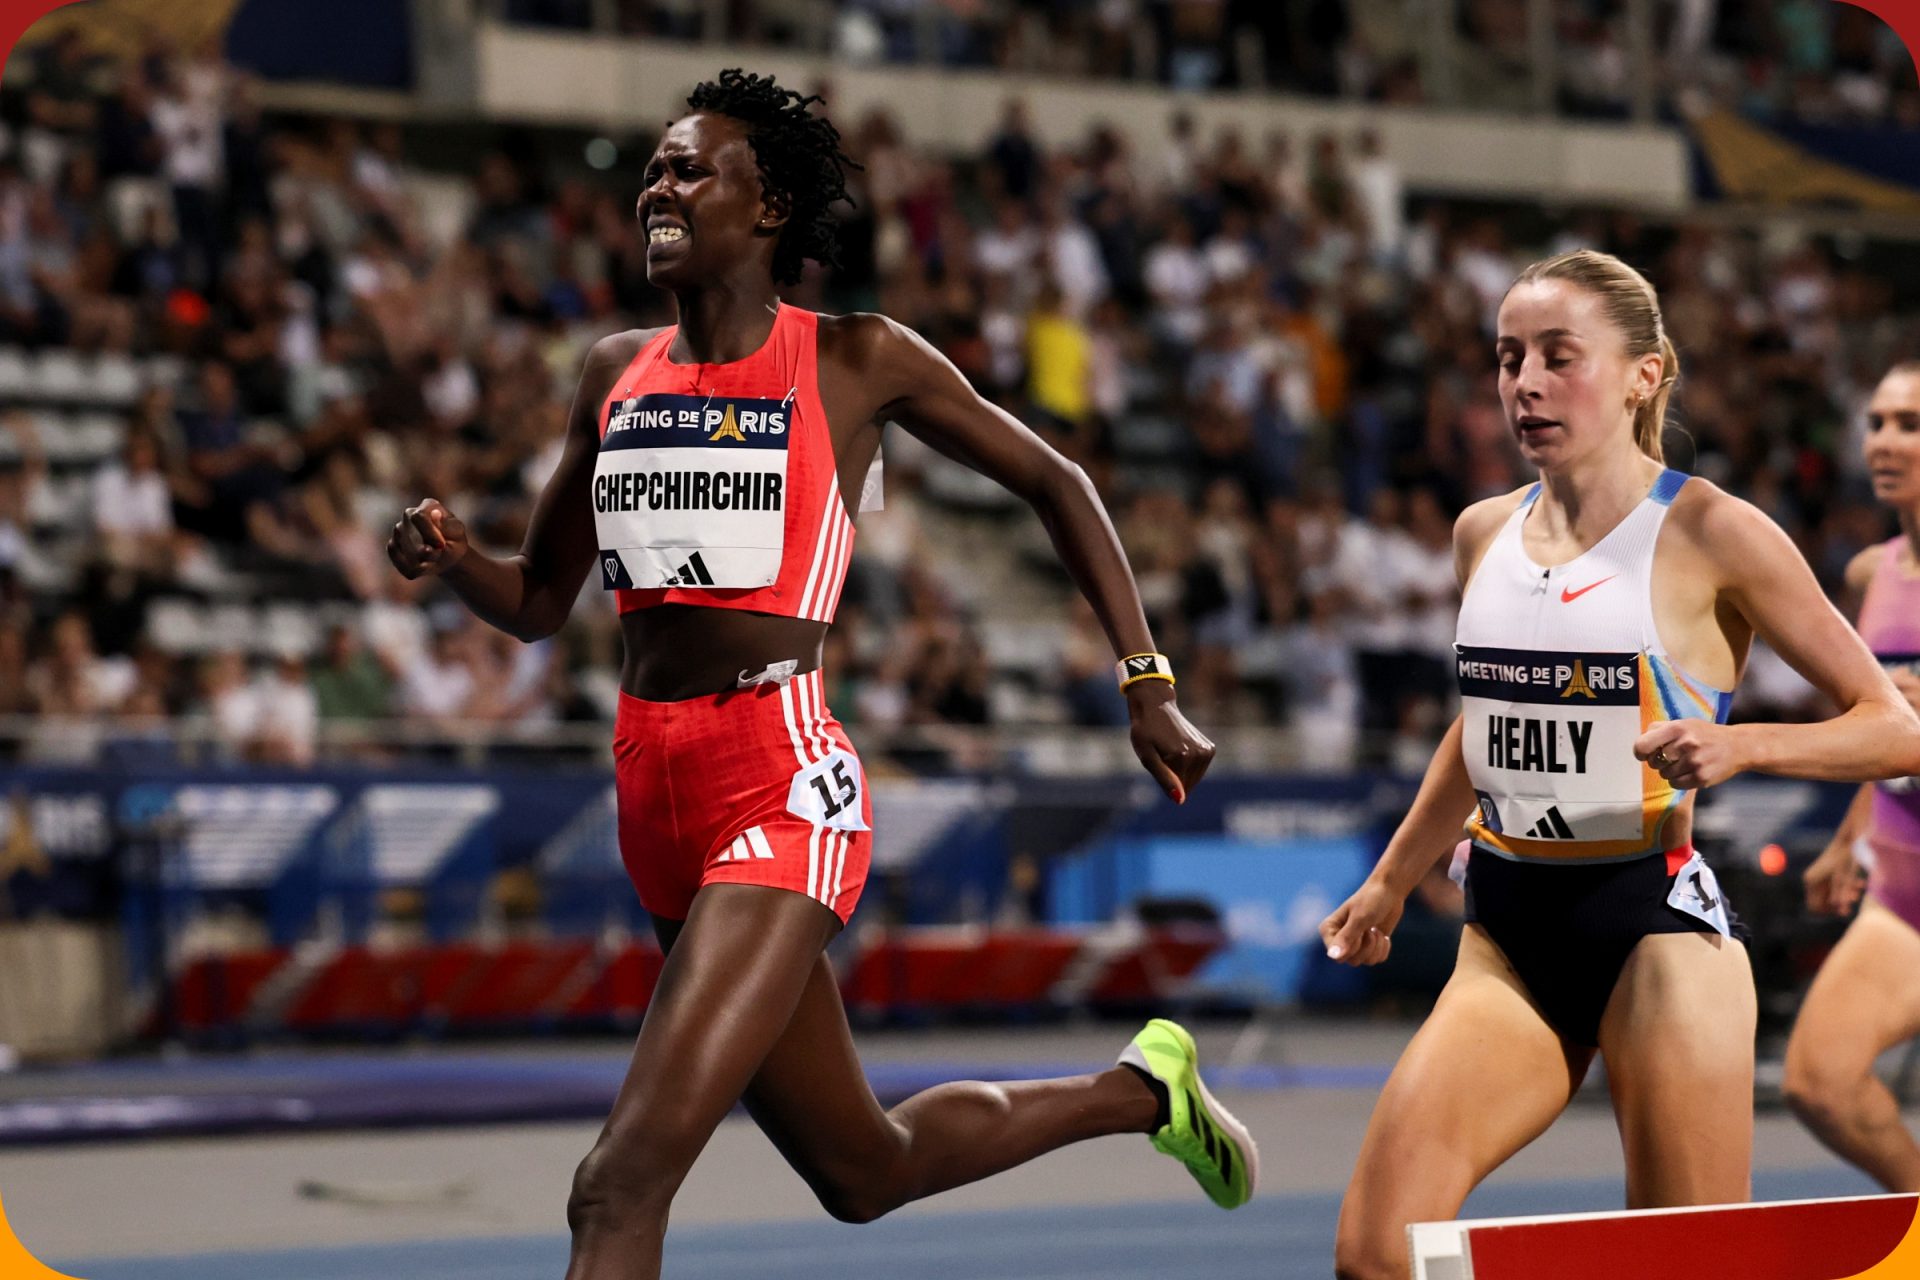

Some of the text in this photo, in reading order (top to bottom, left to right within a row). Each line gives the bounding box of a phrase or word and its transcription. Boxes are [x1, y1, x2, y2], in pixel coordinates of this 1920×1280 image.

[607, 403, 786, 442] MEETING DE PARIS
[595, 471, 783, 513] CHEPCHIRCHIR
[1459, 659, 1634, 698] MEETING DE PARIS
[1488, 714, 1593, 774] HEALY
[810, 760, 857, 820] 15
[1688, 871, 1719, 912] 1
